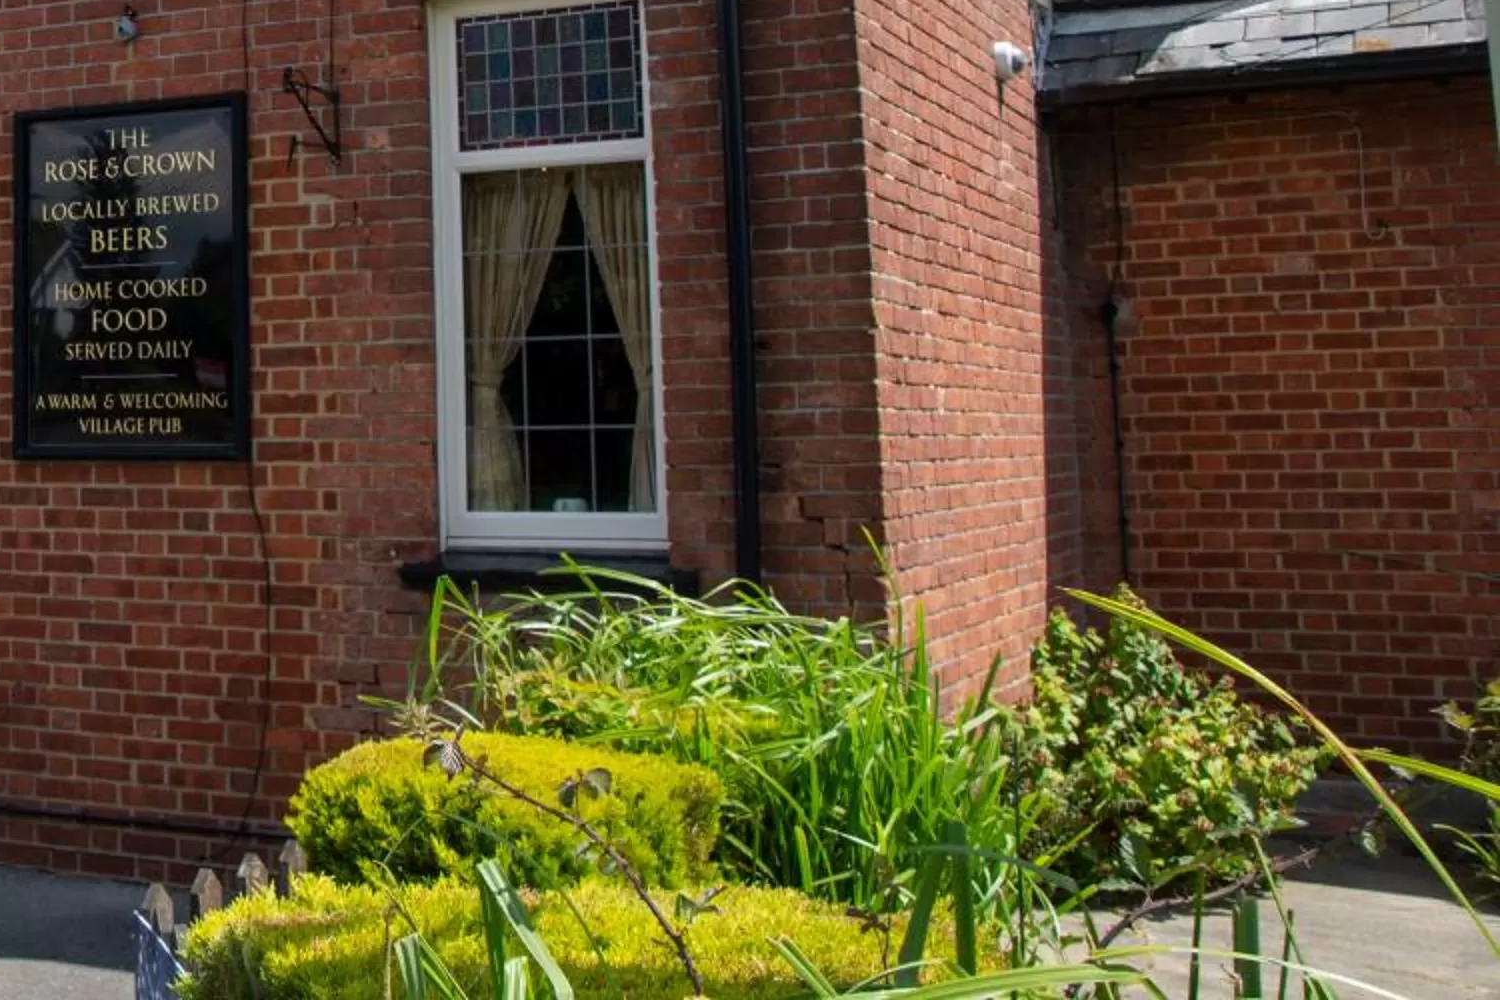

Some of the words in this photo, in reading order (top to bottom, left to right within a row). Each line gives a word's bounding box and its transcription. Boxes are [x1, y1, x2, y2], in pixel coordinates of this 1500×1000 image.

[105, 127, 150, 150] THE
[45, 159, 98, 182] ROSE
[123, 150, 216, 178] CROWN
[42, 199, 128, 222] LOCALLY
[135, 193, 219, 215] BREWED
[90, 226, 168, 253] BEERS
[55, 281, 113, 301] HOME
[118, 277, 207, 299] COOKED
[92, 308, 167, 333] FOOD
[65, 341, 133, 361] SERVED
[138, 340, 193, 359] DAILY
[47, 393, 97, 410] WARM
[104, 393, 114, 409] &
[119, 392, 228, 409] WELCOMING
[78, 416, 145, 434] VILLAGE
[149, 416, 182, 433] PUB
